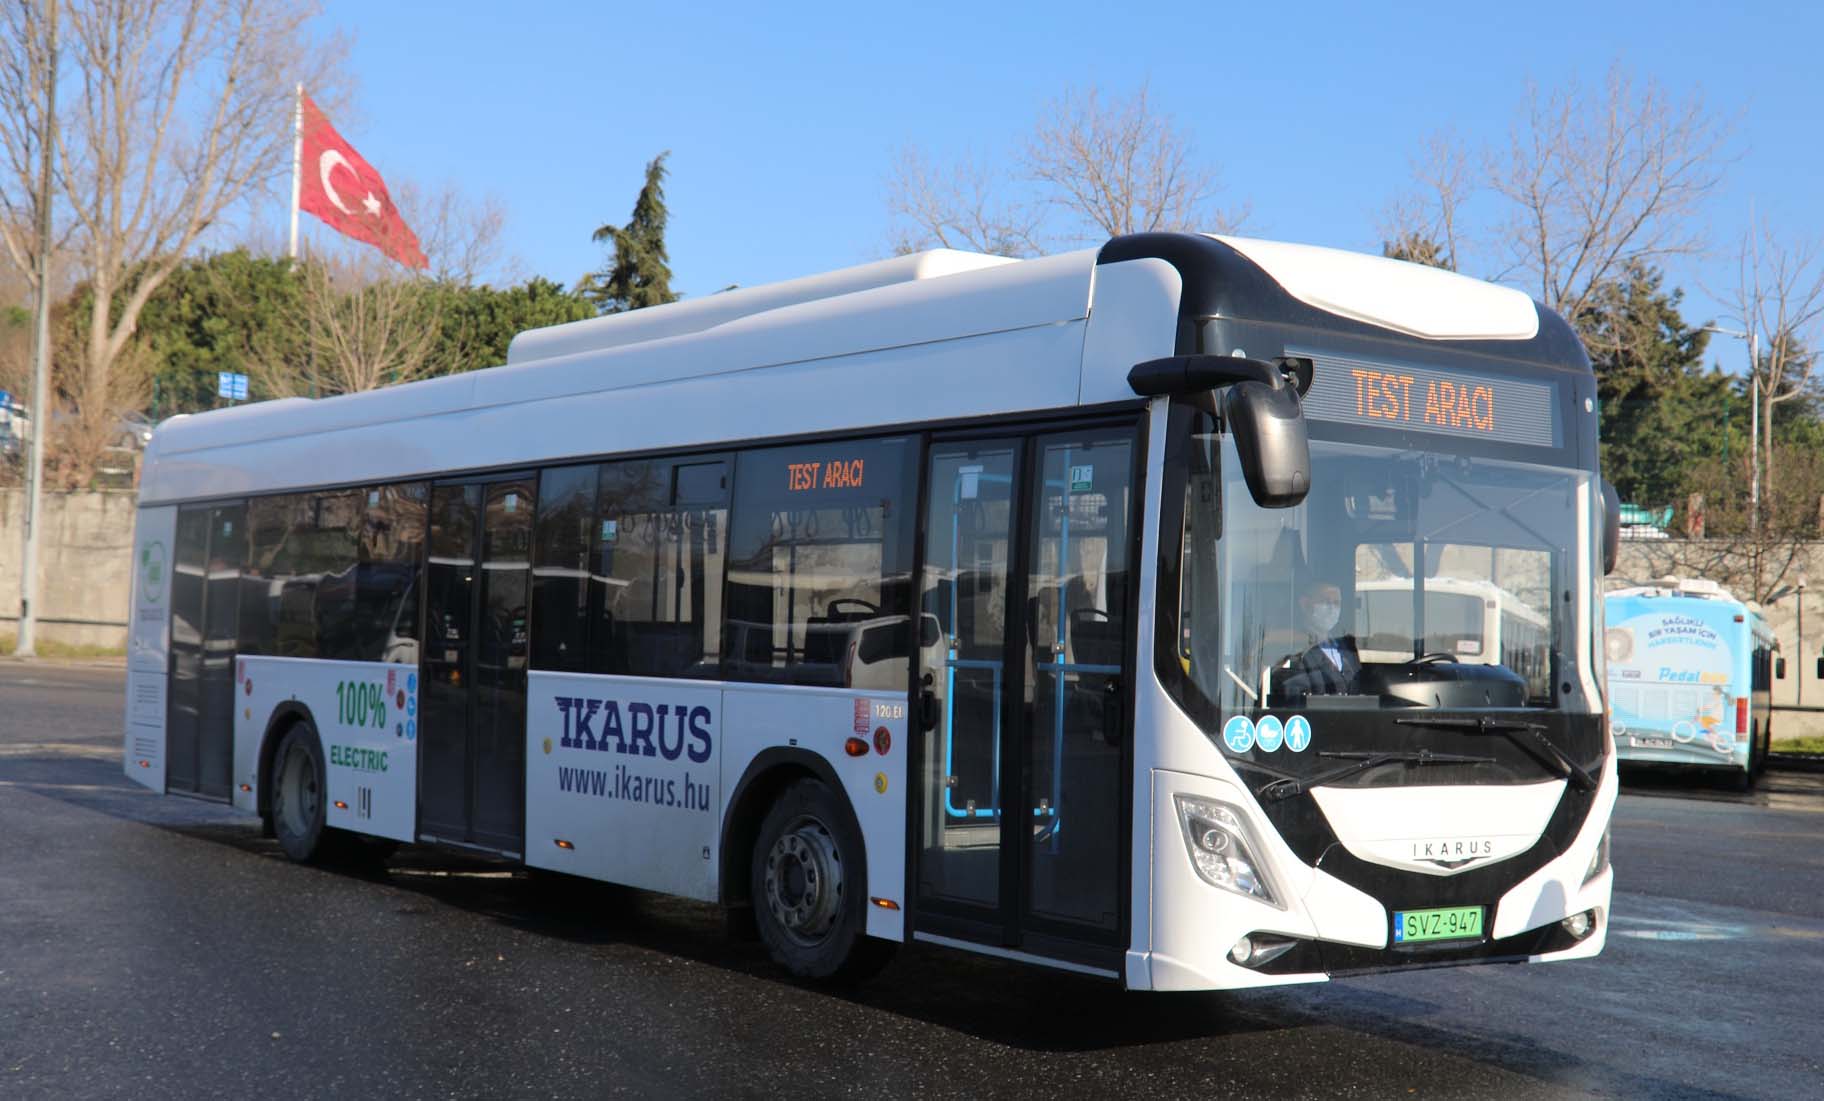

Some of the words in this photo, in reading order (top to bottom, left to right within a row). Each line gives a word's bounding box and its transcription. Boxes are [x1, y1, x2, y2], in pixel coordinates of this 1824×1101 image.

[1352, 368, 1414, 421] TEST
[1424, 380, 1493, 431] ARACI
[788, 463, 820, 491] TEST
[823, 459, 864, 489] ARACI
[336, 680, 386, 729] 100%
[876, 704, 891, 719] 120
[554, 696, 712, 763] IKARUS
[331, 745, 388, 772] ELECTRIC
[559, 765, 710, 812] www.ikarus.hu
[1413, 841, 1491, 857] IKARUS
[1407, 911, 1477, 937] SVZ-947
